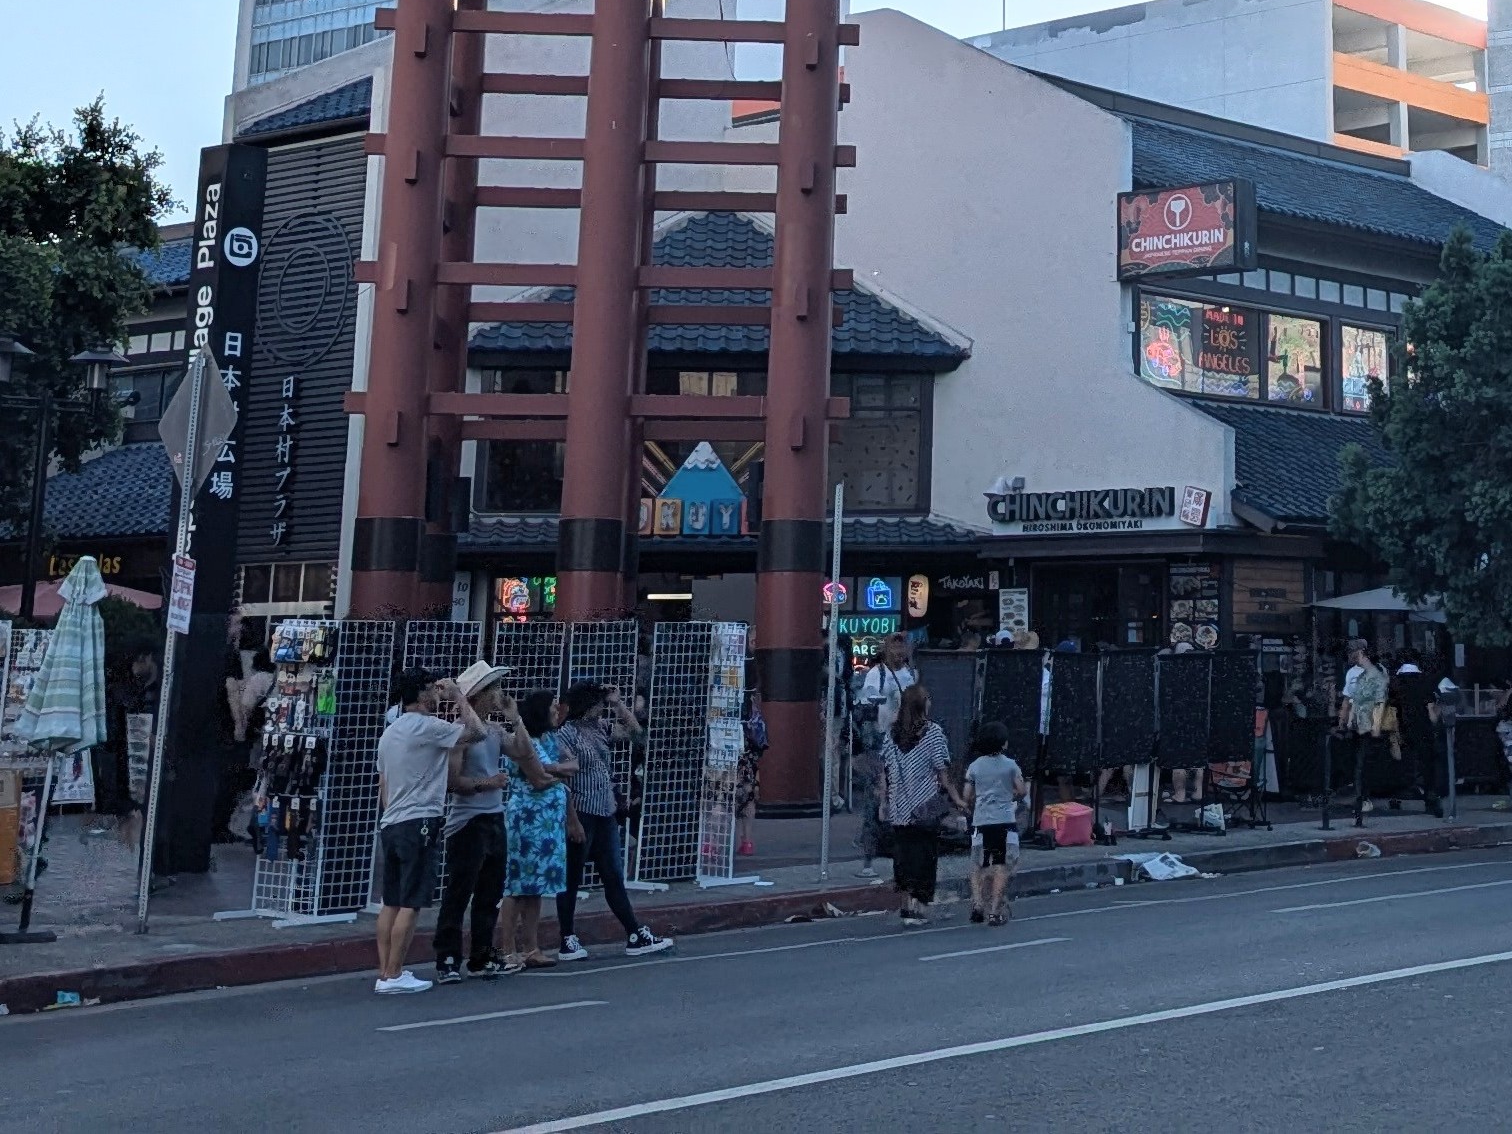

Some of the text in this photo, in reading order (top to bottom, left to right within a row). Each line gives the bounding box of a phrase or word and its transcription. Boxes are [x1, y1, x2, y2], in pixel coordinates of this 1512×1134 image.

[1131, 227, 1225, 253] CHINCHIKURIN
[188, 182, 221, 370] llage Plaza
[1210, 328, 1239, 350] LOS
[1198, 351, 1251, 375] ANGELES
[210, 331, 242, 500] 日本広場
[270, 375, 296, 547] 日本村プラザ
[985, 487, 1175, 522] CHINCHIKURIN
[1022, 519, 1143, 533] HIROSHIMA OKONOMIYAKI
[938, 574, 984, 590] TAKOYAKI
